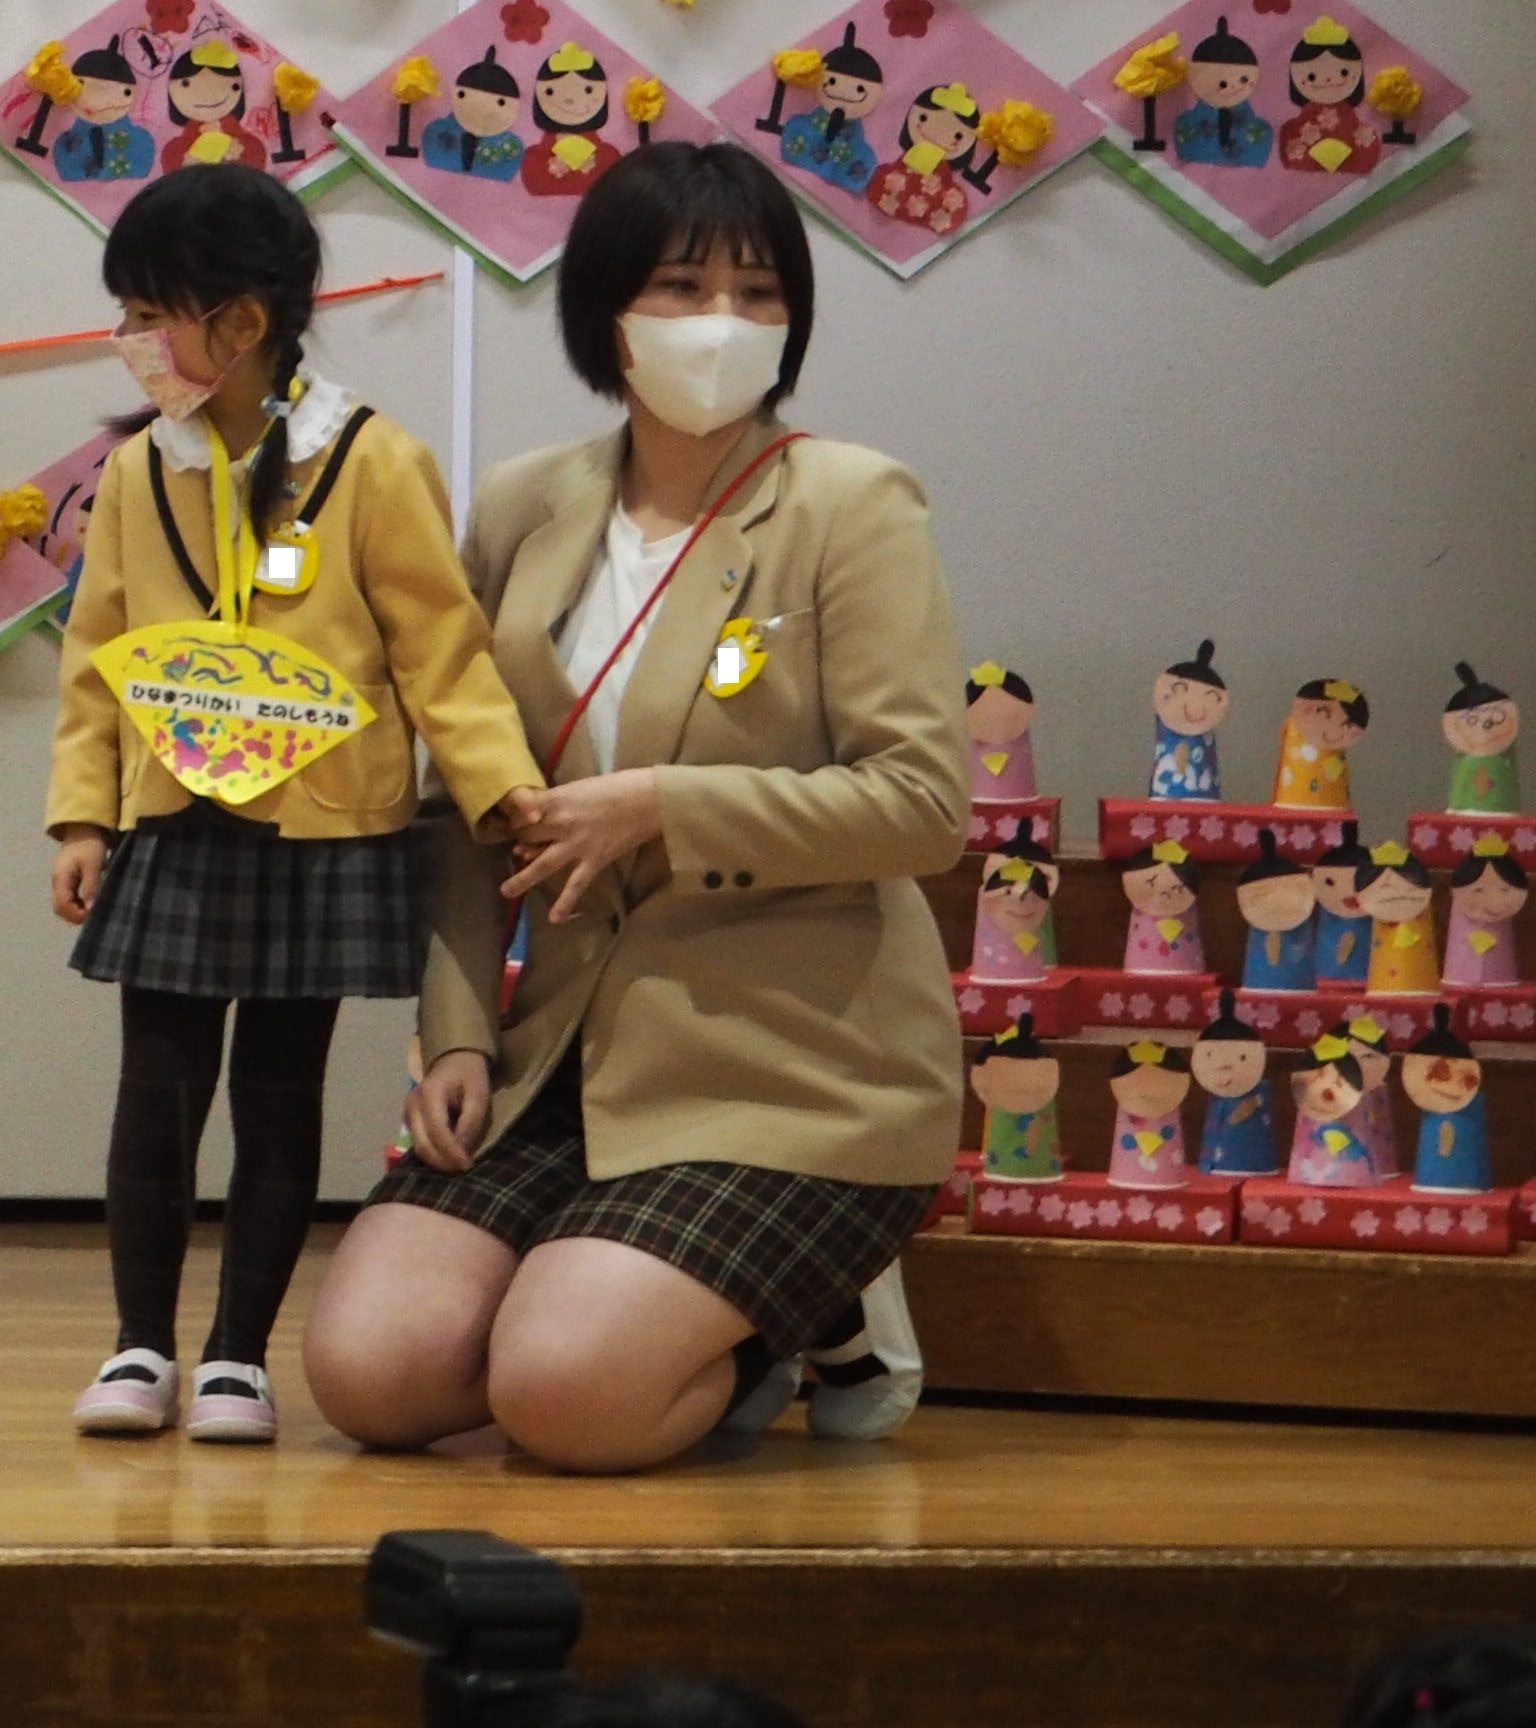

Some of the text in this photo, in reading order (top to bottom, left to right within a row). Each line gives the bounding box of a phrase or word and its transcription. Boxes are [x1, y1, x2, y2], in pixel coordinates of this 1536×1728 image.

[131, 683, 350, 727] ひなまつりかい たのしもうね
